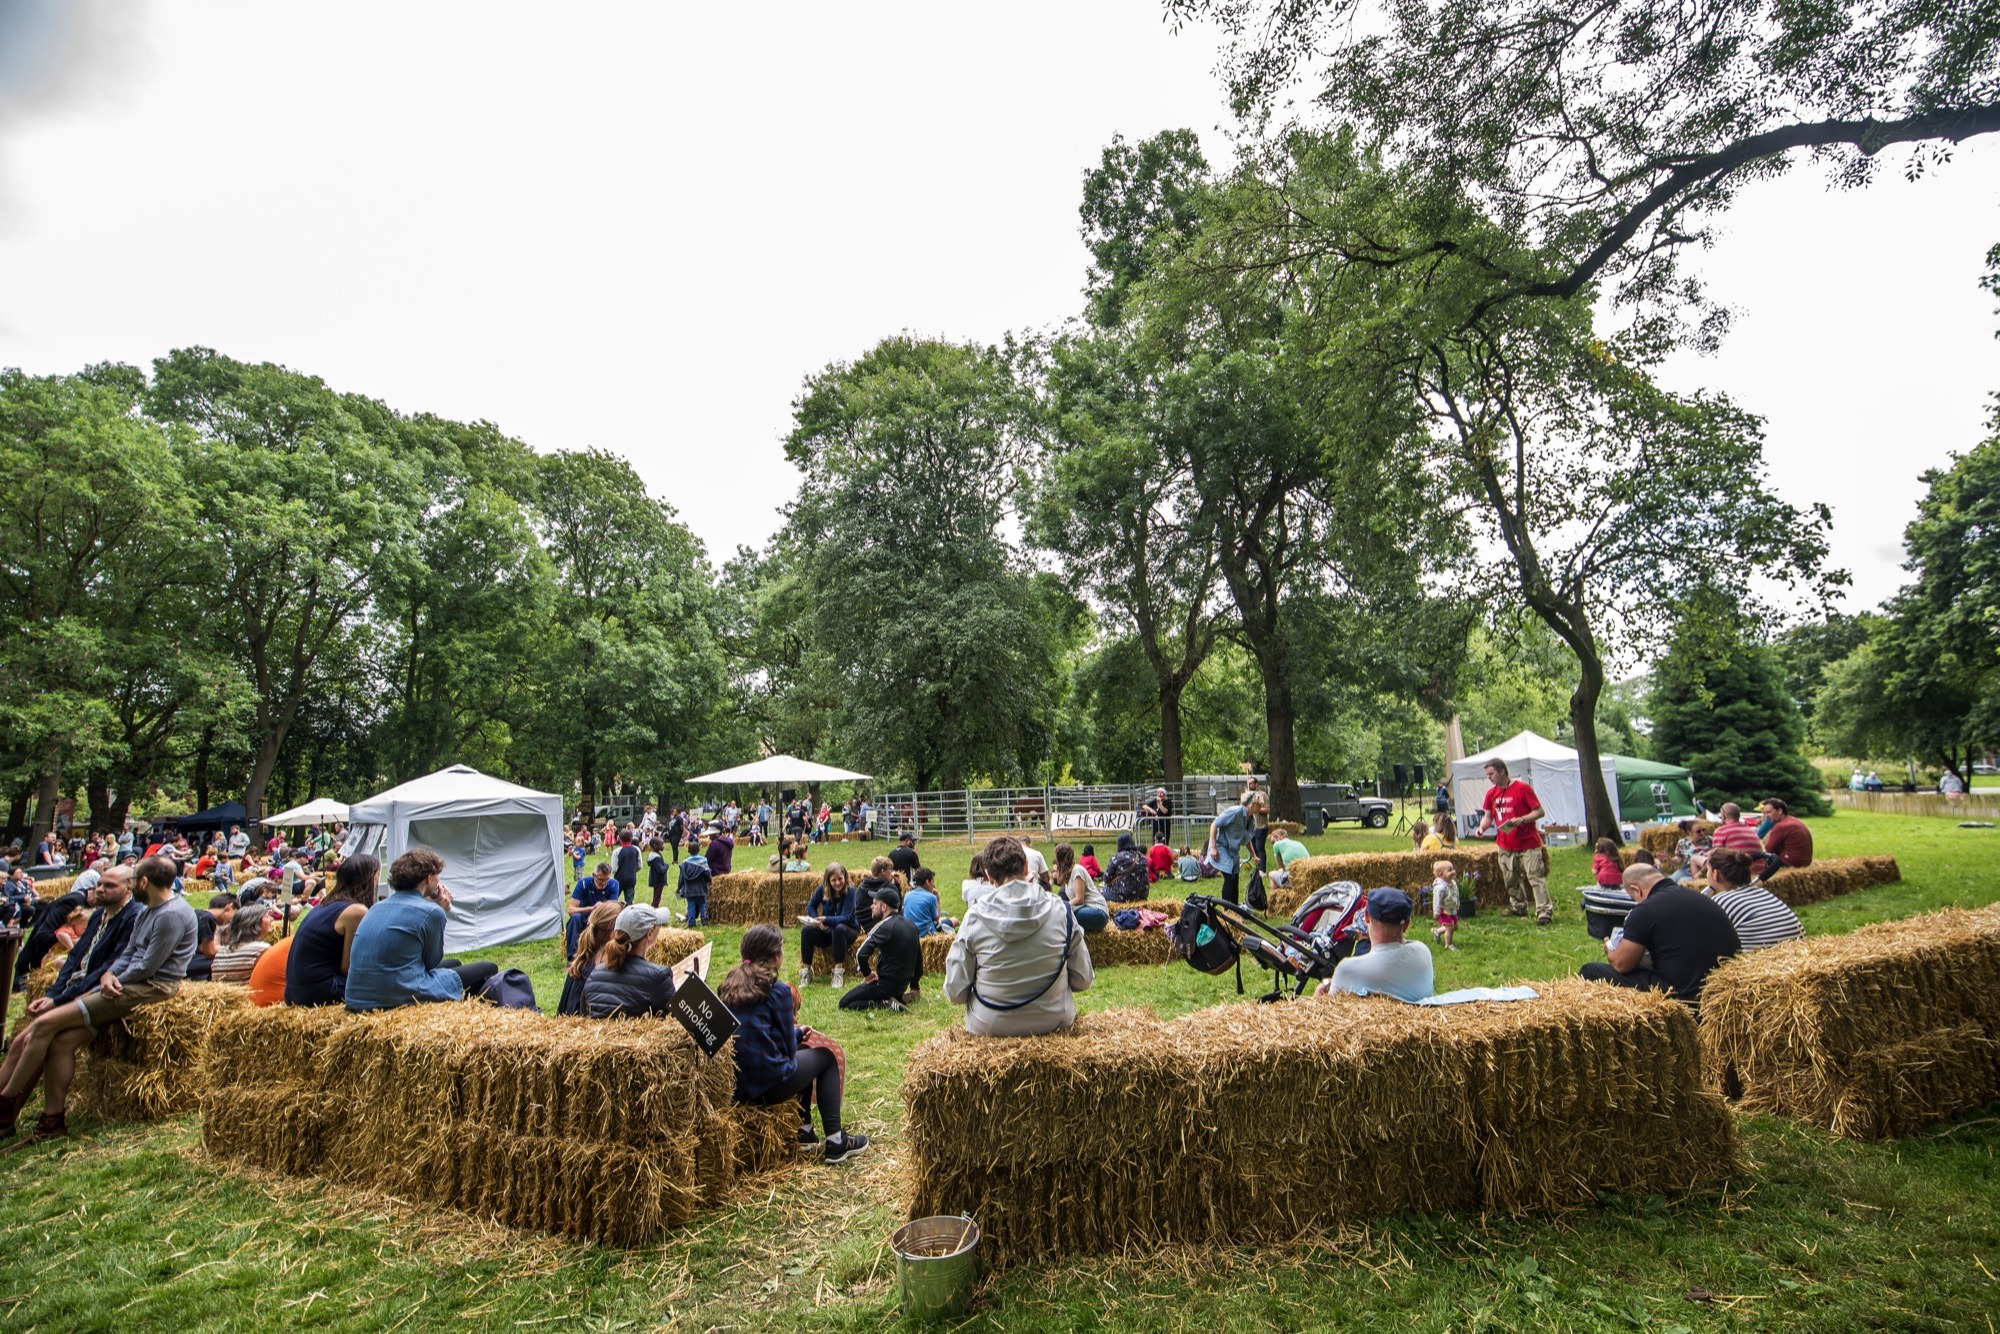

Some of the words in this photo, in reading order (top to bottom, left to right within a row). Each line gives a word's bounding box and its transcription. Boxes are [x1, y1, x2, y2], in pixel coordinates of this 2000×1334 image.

[1056, 813, 1073, 828] BE
[698, 1000, 713, 1020] No
[678, 999, 717, 1046] smoking
